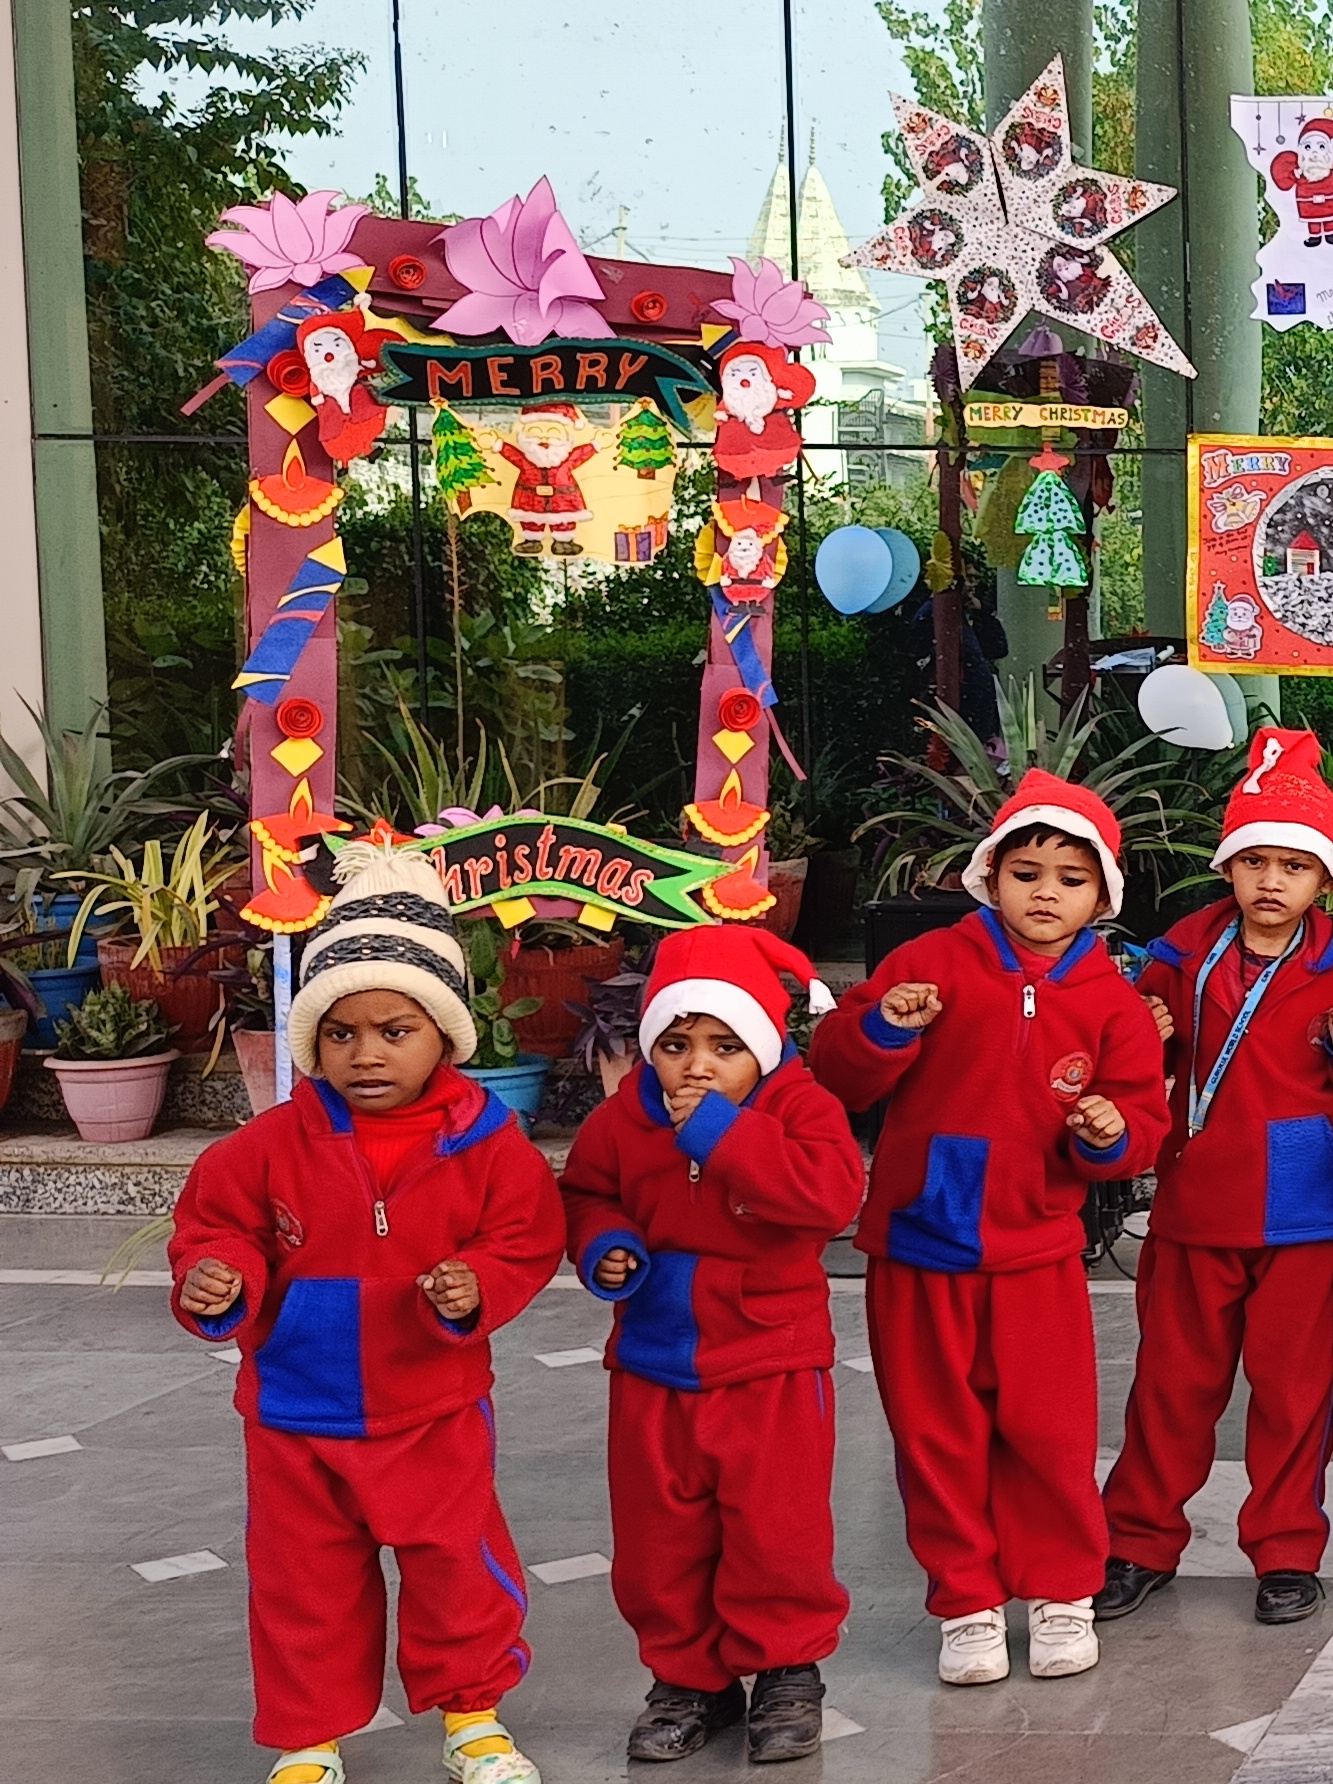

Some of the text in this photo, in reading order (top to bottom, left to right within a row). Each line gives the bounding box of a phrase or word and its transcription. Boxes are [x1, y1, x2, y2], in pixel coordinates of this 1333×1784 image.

[427, 352, 649, 398] MERRY
[969, 406, 1126, 426] MERRY CHRISTMAS
[1202, 452, 1290, 486] MERRY
[432, 823, 656, 906] hristmas
